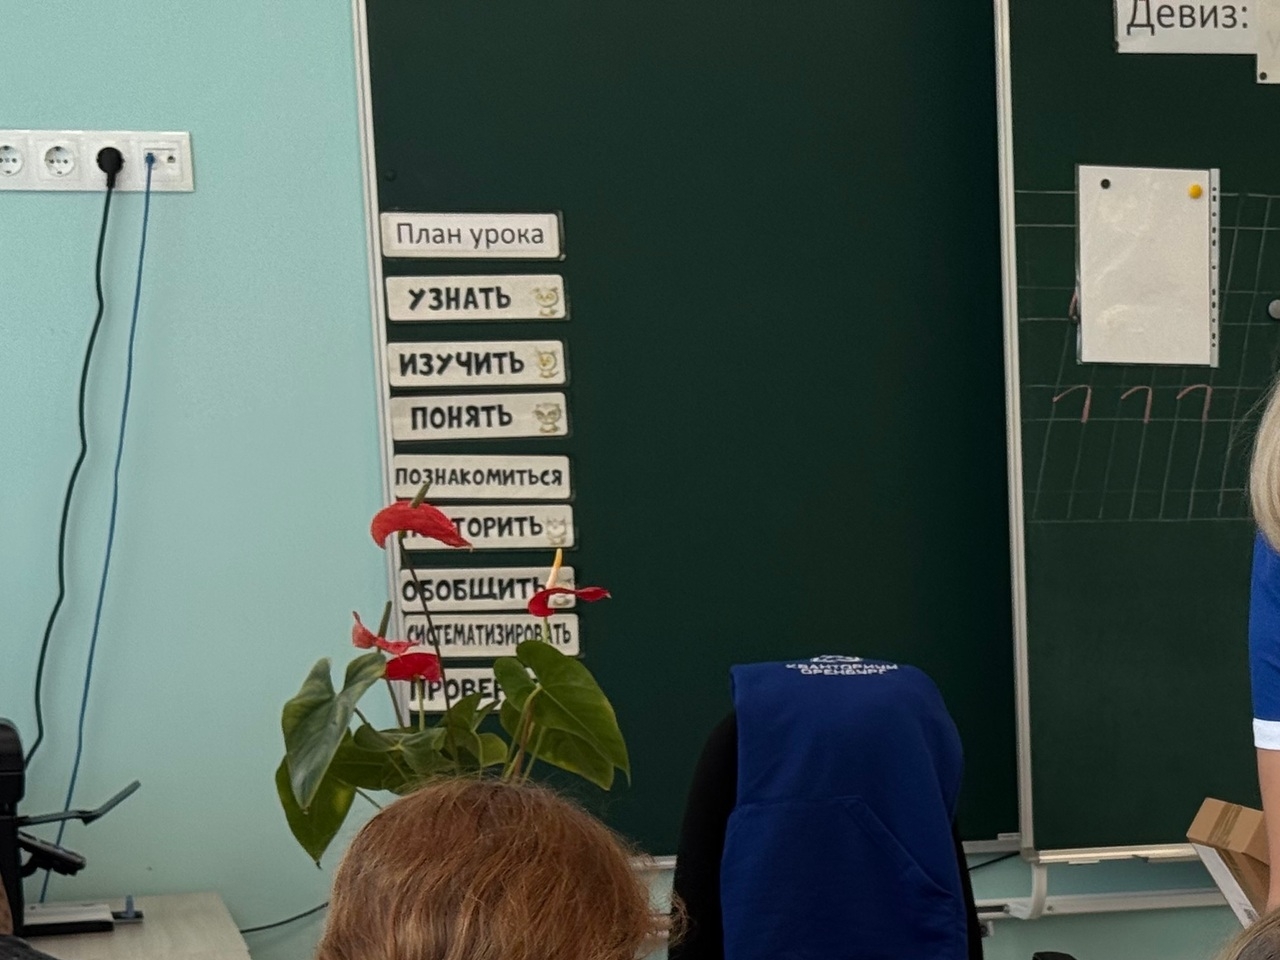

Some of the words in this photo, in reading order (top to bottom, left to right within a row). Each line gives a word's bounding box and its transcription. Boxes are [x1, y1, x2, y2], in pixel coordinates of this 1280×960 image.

[1126, 0, 1248, 36] Девиз:
[396, 223, 462, 244] План
[469, 227, 545, 249] урока
[408, 286, 512, 311] УЗНАТЬ
[399, 351, 525, 376] ИЗУЧИТЬ
[411, 404, 513, 430] ПОНЯТЬ
[395, 467, 563, 486] ПОЗНАКОМИТЬСЯ
[405, 515, 544, 538] ТОРИТЬ
